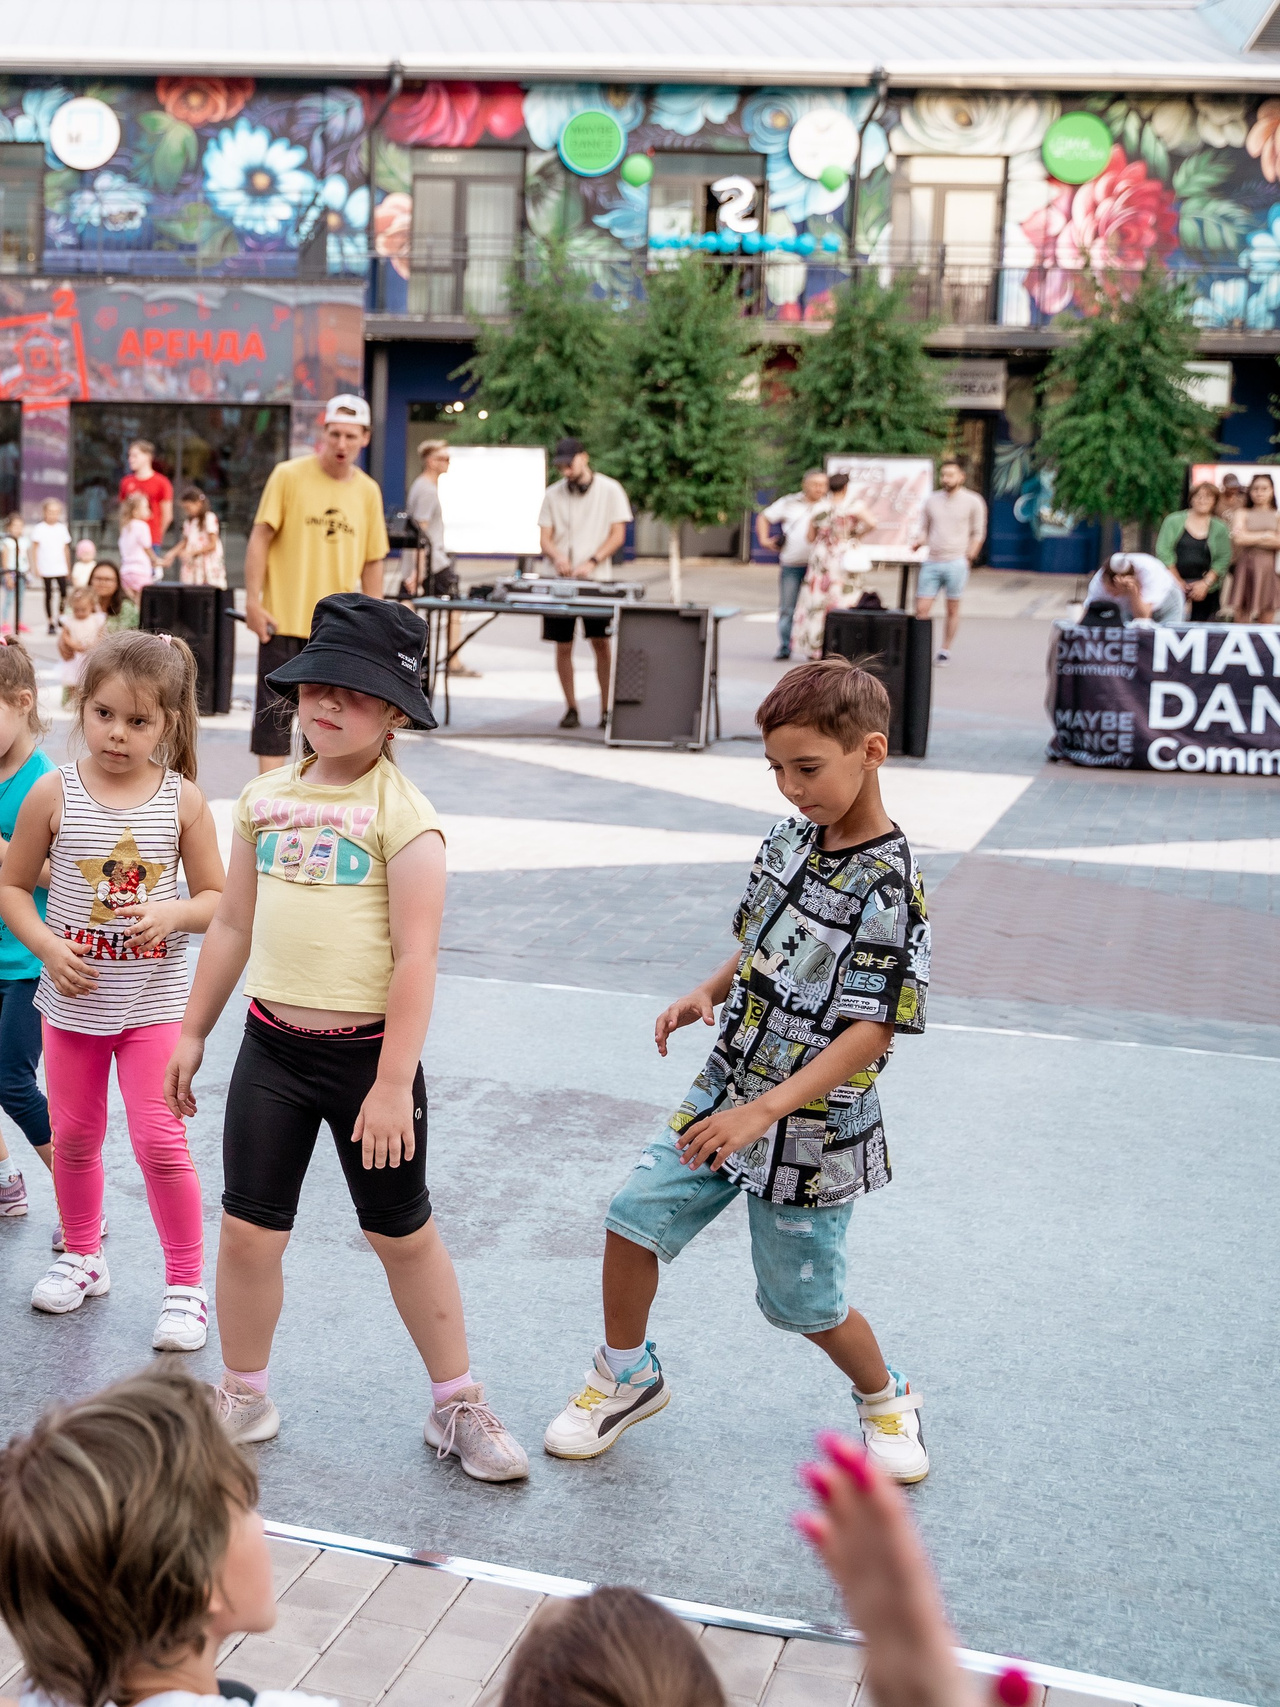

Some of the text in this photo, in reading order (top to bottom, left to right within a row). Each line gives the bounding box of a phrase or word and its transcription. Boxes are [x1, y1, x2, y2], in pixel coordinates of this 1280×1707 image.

[118, 328, 266, 364] АРЕНДА
[1057, 641, 1138, 663] DANCE
[1055, 709, 1135, 731] MAYBE
[252, 798, 378, 840] SUNNY
[766, 1018, 831, 1048] THE RULES
[771, 1006, 816, 1031] BREAK
[835, 1102, 881, 1140] BREAK
